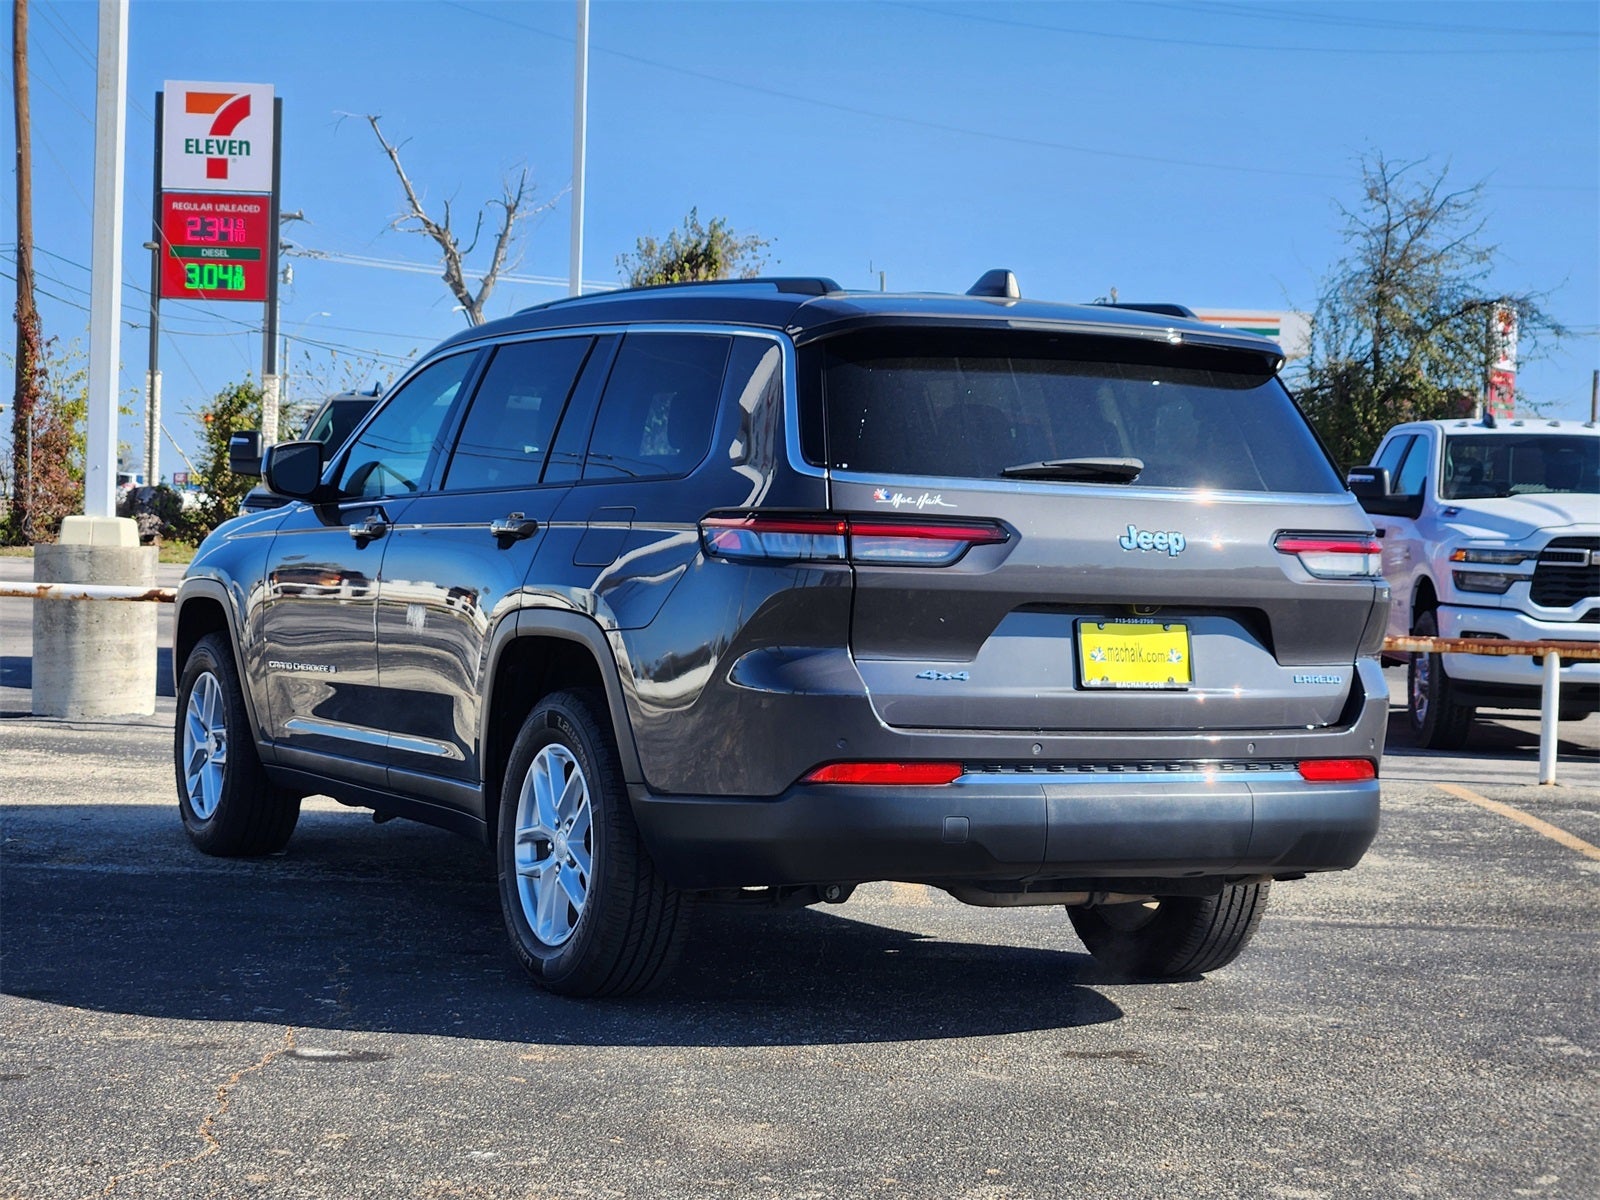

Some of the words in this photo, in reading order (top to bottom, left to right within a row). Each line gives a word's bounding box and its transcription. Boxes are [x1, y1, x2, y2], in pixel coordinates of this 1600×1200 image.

[186, 92, 251, 136] 7
[172, 201, 213, 211] REGULAR
[215, 203, 261, 213] UNLEADED
[186, 216, 234, 242] 2.34
[201, 248, 230, 258] DIESEL
[1119, 524, 1187, 557] Jeep
[1107, 642, 1166, 663] machaik.com
[268, 660, 293, 671] GRAND
[293, 662, 329, 673] CHEROKEE
[1293, 674, 1342, 684] LAREDO
